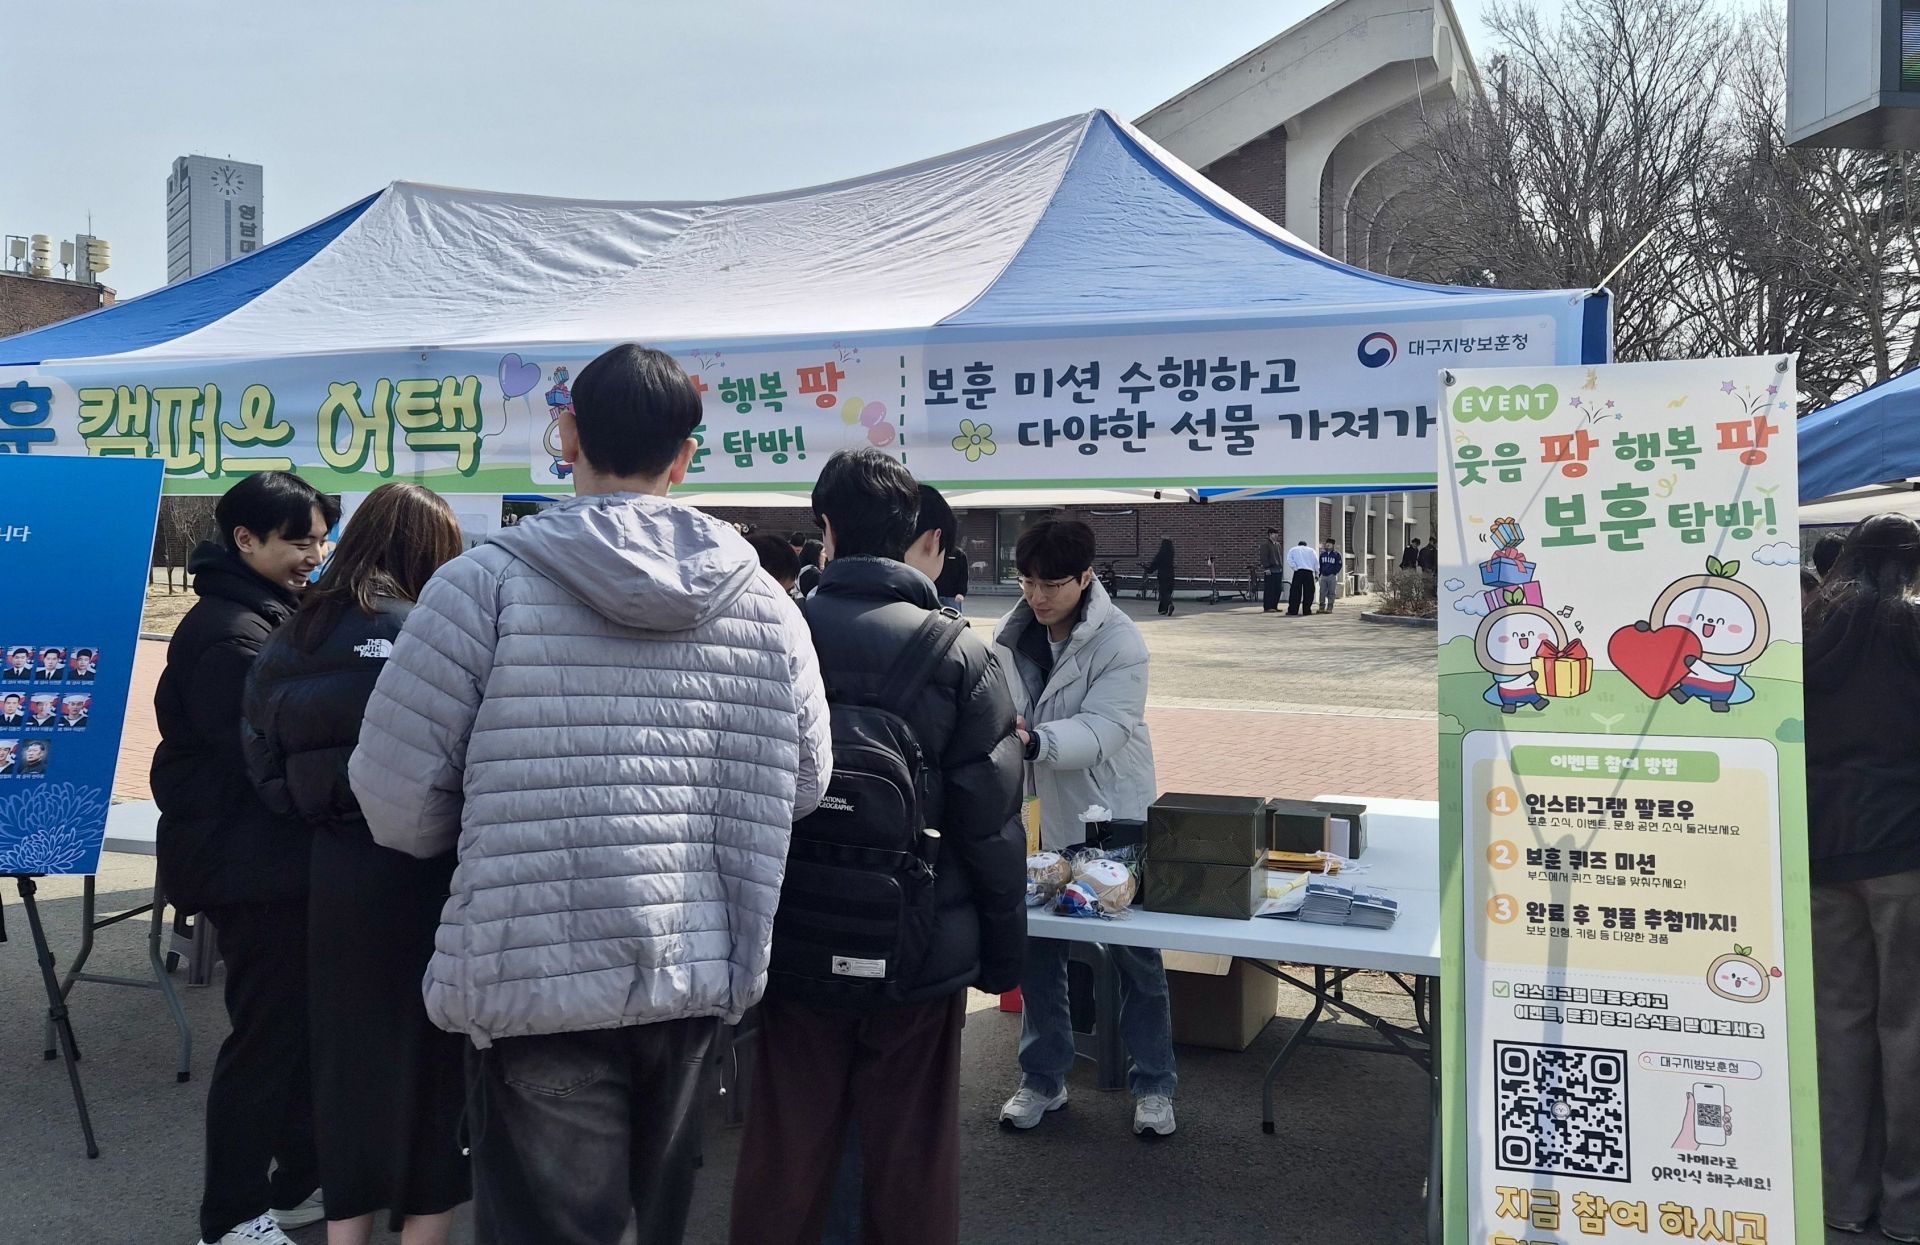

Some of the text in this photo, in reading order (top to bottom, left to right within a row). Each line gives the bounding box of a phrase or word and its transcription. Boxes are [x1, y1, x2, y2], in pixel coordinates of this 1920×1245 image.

[1408, 333, 1529, 356] 대구지방보훈청
[718, 361, 846, 414] 행복 팡
[924, 356, 1300, 410] 보훈 미션 수행하고
[1461, 393, 1549, 413] EVENT
[77, 382, 296, 479] 캠퍼스
[317, 374, 483, 477] 어택
[1017, 408, 1155, 456] 다양한
[1170, 404, 1260, 456] 선물
[723, 426, 807, 468] 탐방!
[1454, 415, 1780, 488] 웃음 팡 행복 팡
[1540, 482, 1778, 552] 보훈 탐방!
[366, 638, 383, 646] THE
[1550, 755, 1678, 775] 이벤트 참여 방법
[1495, 792, 1695, 820] 1 인스타그램 팔로우
[1527, 816, 1547, 826] 보훈
[1613, 820, 1634, 831] 문화
[1637, 821, 1659, 832] 공연
[1662, 822, 1683, 834] 소식
[1686, 824, 1740, 836] 둘러보세요
[1495, 845, 1656, 875] 2 보훈 퀴즈 미션
[1527, 871, 1569, 883] 부스에서
[1571, 872, 1593, 884] 퀴즈
[1595, 874, 1627, 886] 정답을
[1495, 898, 1738, 933] 3 완료 후 경품 추첨까지!
[1526, 925, 1546, 936] 보보
[1613, 931, 1645, 943] 다양한
[1514, 983, 1589, 1003] 인스타그램
[1600, 1010, 1632, 1028] 공연
[1635, 1013, 1682, 1032] 소식을
[1660, 1056, 1739, 1074] 대구지방보훈청
[1677, 1153, 1739, 1170] 카메라로
[1651, 1166, 1772, 1192] QR인식 해주세요!
[1495, 1185, 1768, 1245] 지금 참여 하시고
